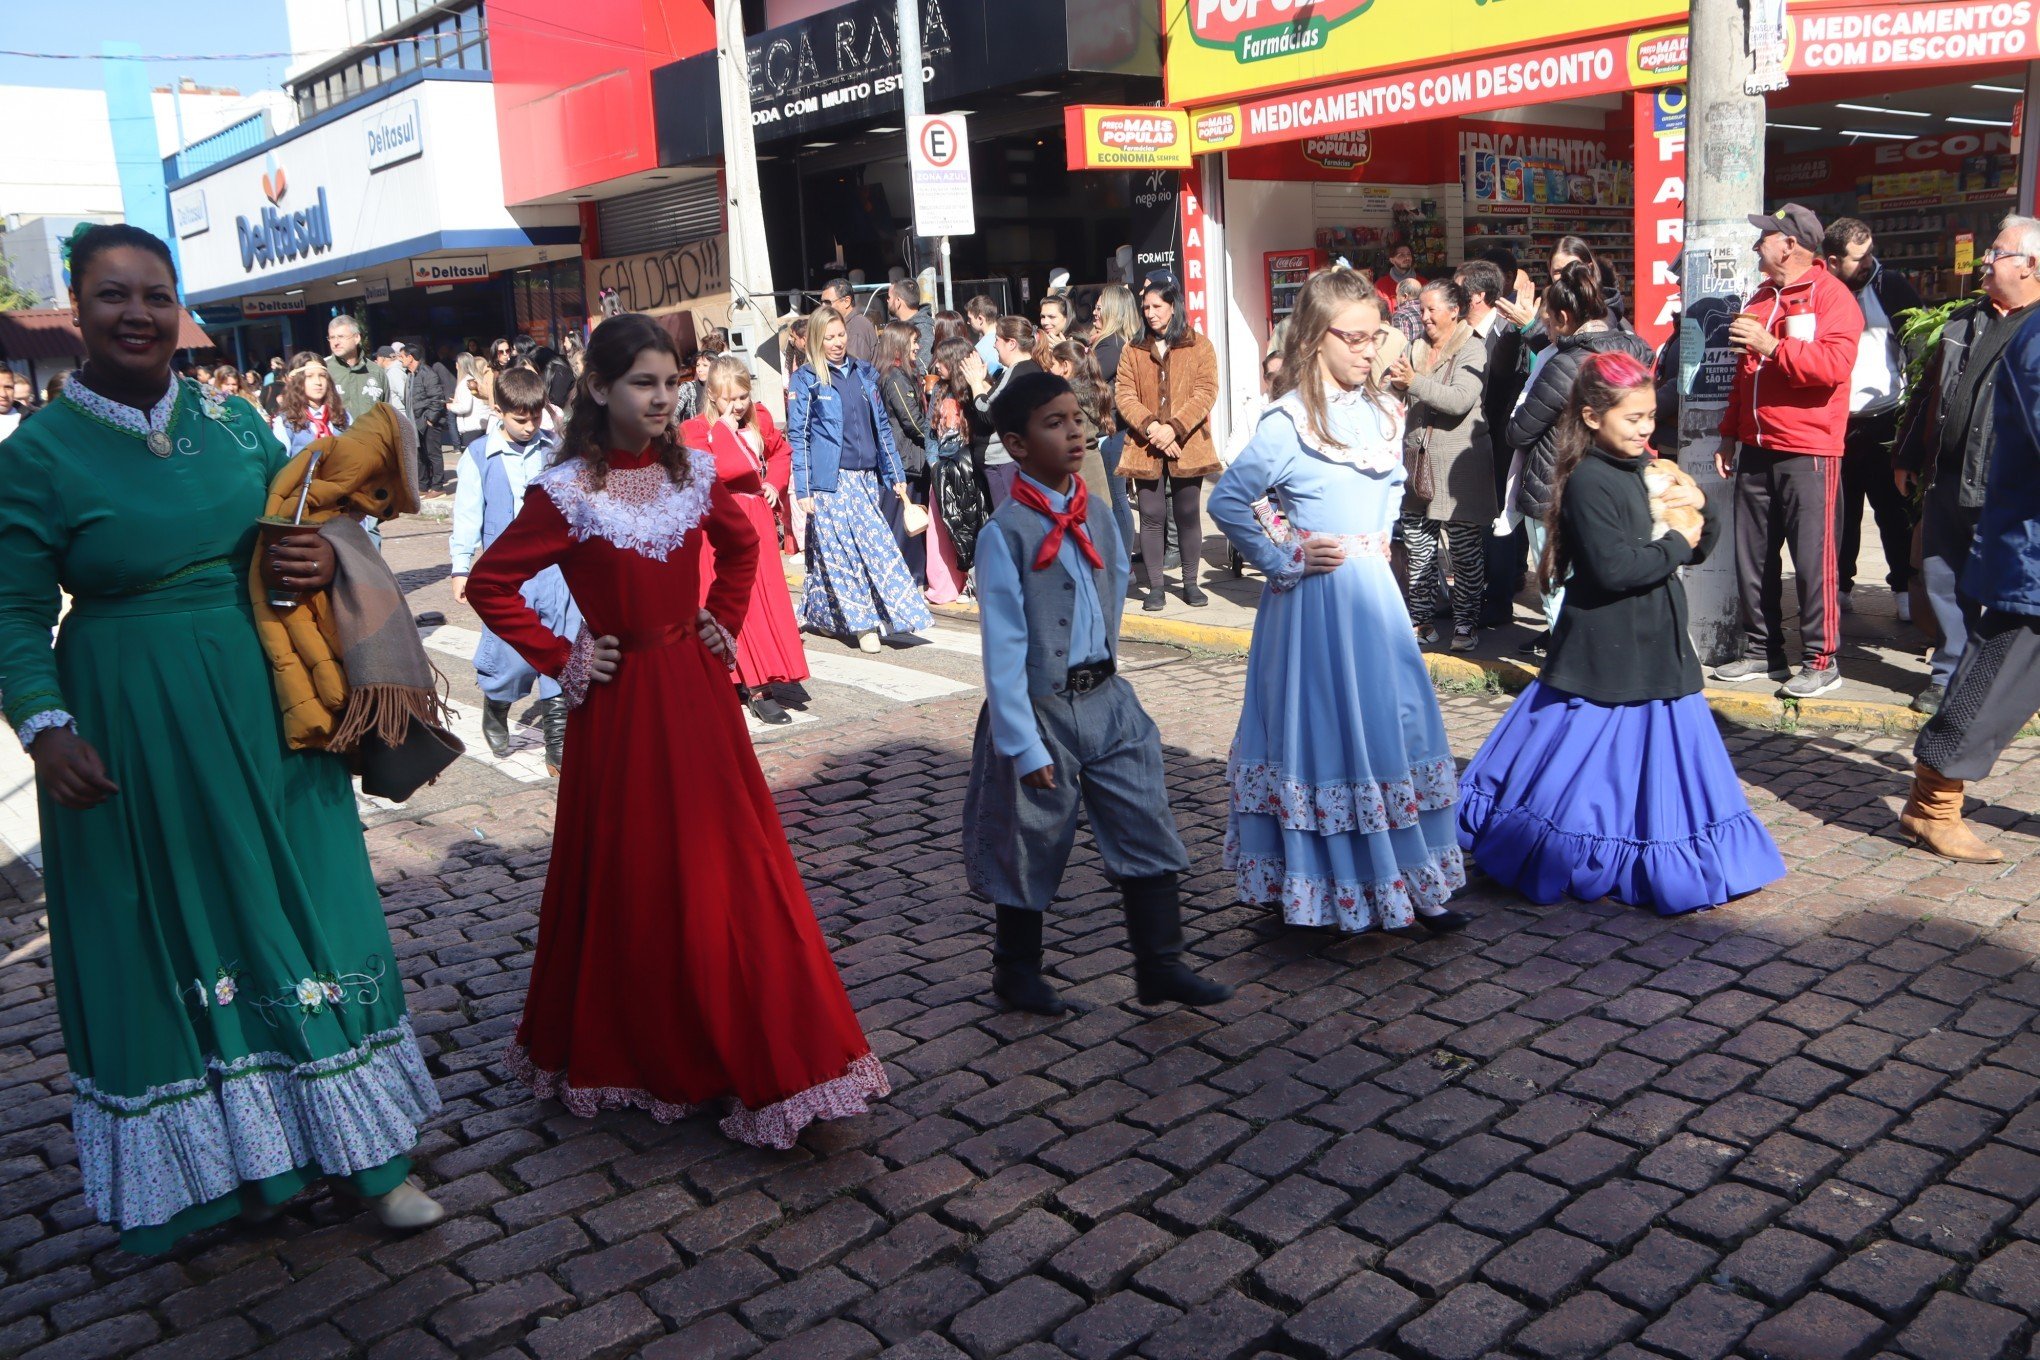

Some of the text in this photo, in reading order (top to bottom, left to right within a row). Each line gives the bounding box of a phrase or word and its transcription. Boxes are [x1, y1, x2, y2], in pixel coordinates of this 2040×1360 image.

[1802, 1, 2032, 41] MEDICAMENTOS
[1243, 26, 1320, 60] Farmácias
[1804, 41, 1868, 67] COM
[1871, 29, 2027, 64] DESCONTO
[748, 32, 819, 96] EÇA
[1640, 50, 1688, 68] POPULA
[751, 66, 935, 126] ODA COM MUITO ESTO
[1250, 48, 1614, 134] MEDICAMENTOS COM DESCONTO
[1101, 119, 1173, 132] PREÇO MAIS
[1207, 114, 1233, 126] MAIS
[367, 114, 415, 156] Deltasul
[1103, 131, 1174, 144] POPULAR
[1198, 124, 1234, 138] POPULAR
[1324, 129, 1367, 143] MAIS
[931, 130, 947, 157] E
[1307, 141, 1368, 158] POPULAR
[1459, 131, 1607, 172] EDICAMENTOS
[1098, 152, 1156, 163] ECONOMIA
[1790, 160, 1826, 172] MAIS
[917, 172, 967, 181] ZONA AZUL
[1775, 169, 1828, 183] POPULAR
[1492, 206, 1529, 214] MEDICAMENTOS
[236, 186, 332, 273] Deltasul
[1137, 251, 1175, 264] FORMITZ
[432, 263, 487, 279] Deltasul
[365, 284, 388, 300] Deltasul
[258, 299, 305, 312] Deltasul
[1705, 374, 1721, 384] SÃO
